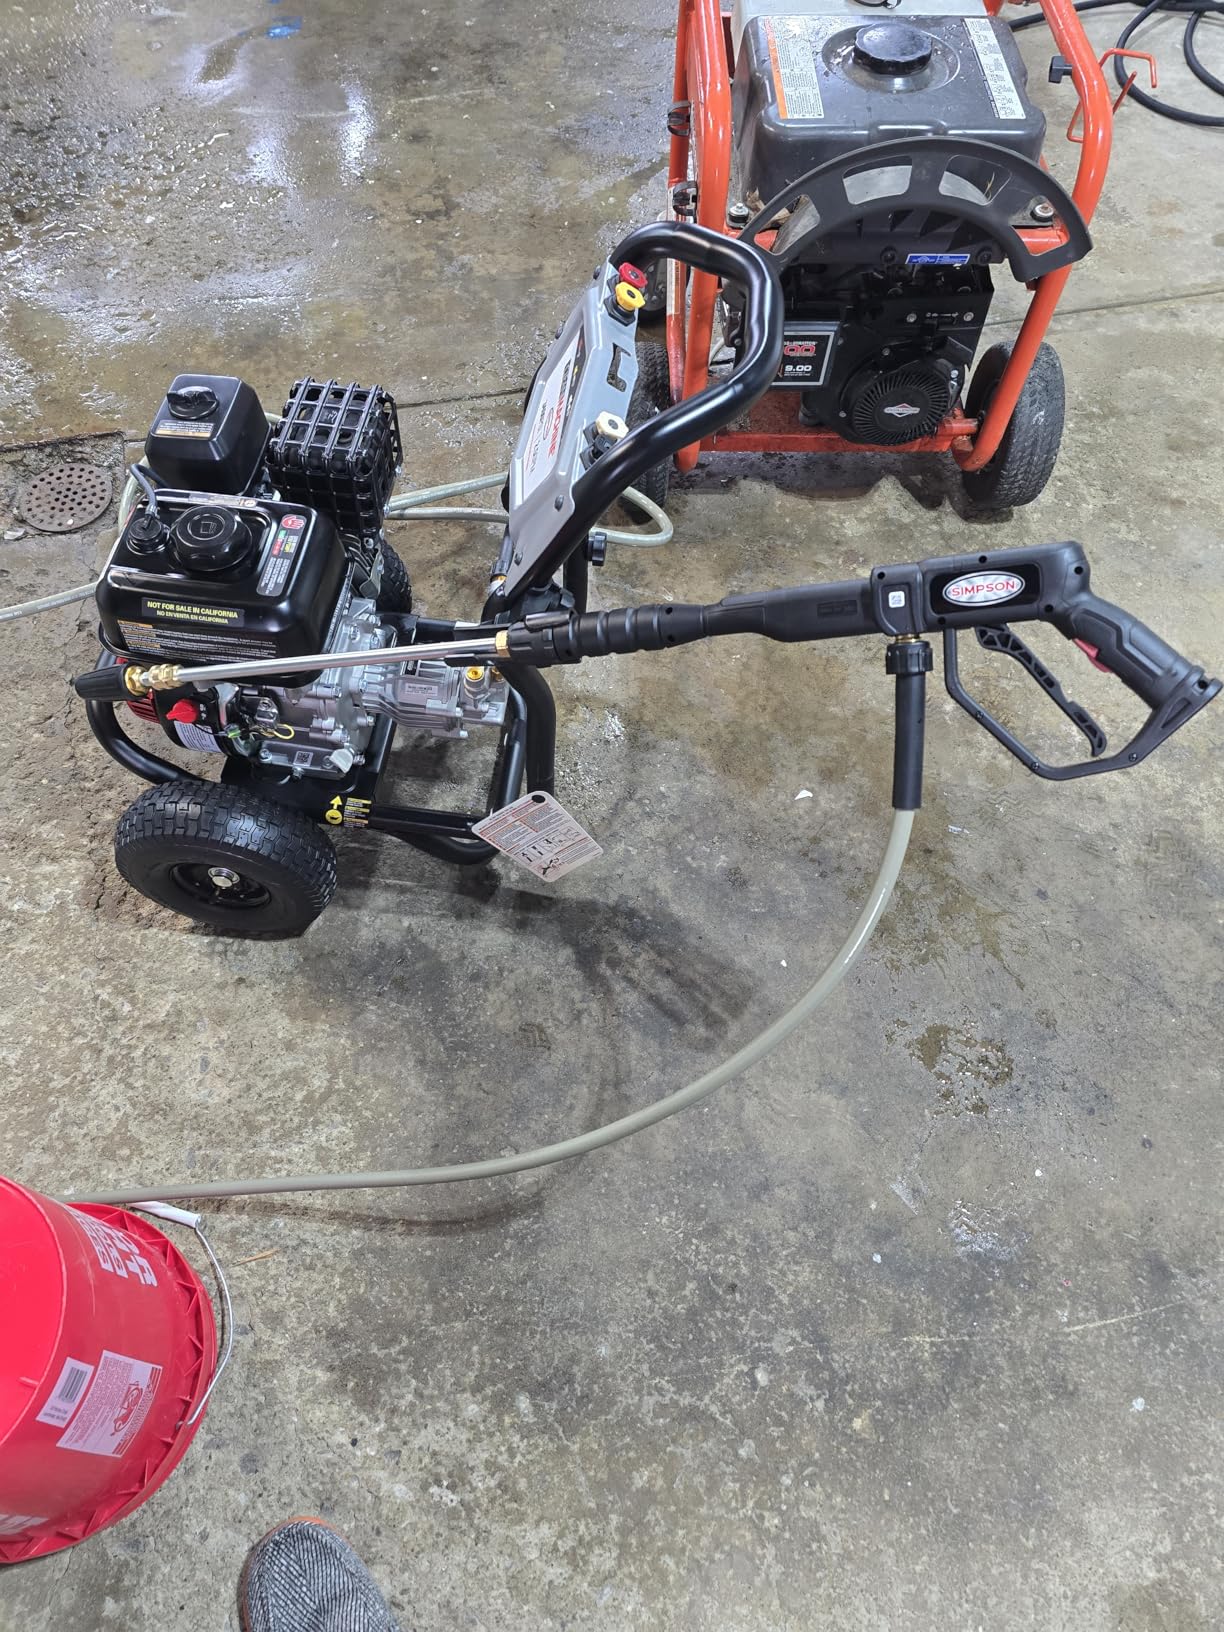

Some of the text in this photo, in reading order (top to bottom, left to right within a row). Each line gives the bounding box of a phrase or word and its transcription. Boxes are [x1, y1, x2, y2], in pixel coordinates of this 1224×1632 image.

[952, 581, 1015, 596] SIMPSON
[201, 608, 238, 618] CALIFORNIA
[199, 615, 228, 624] CALIFORNIA
